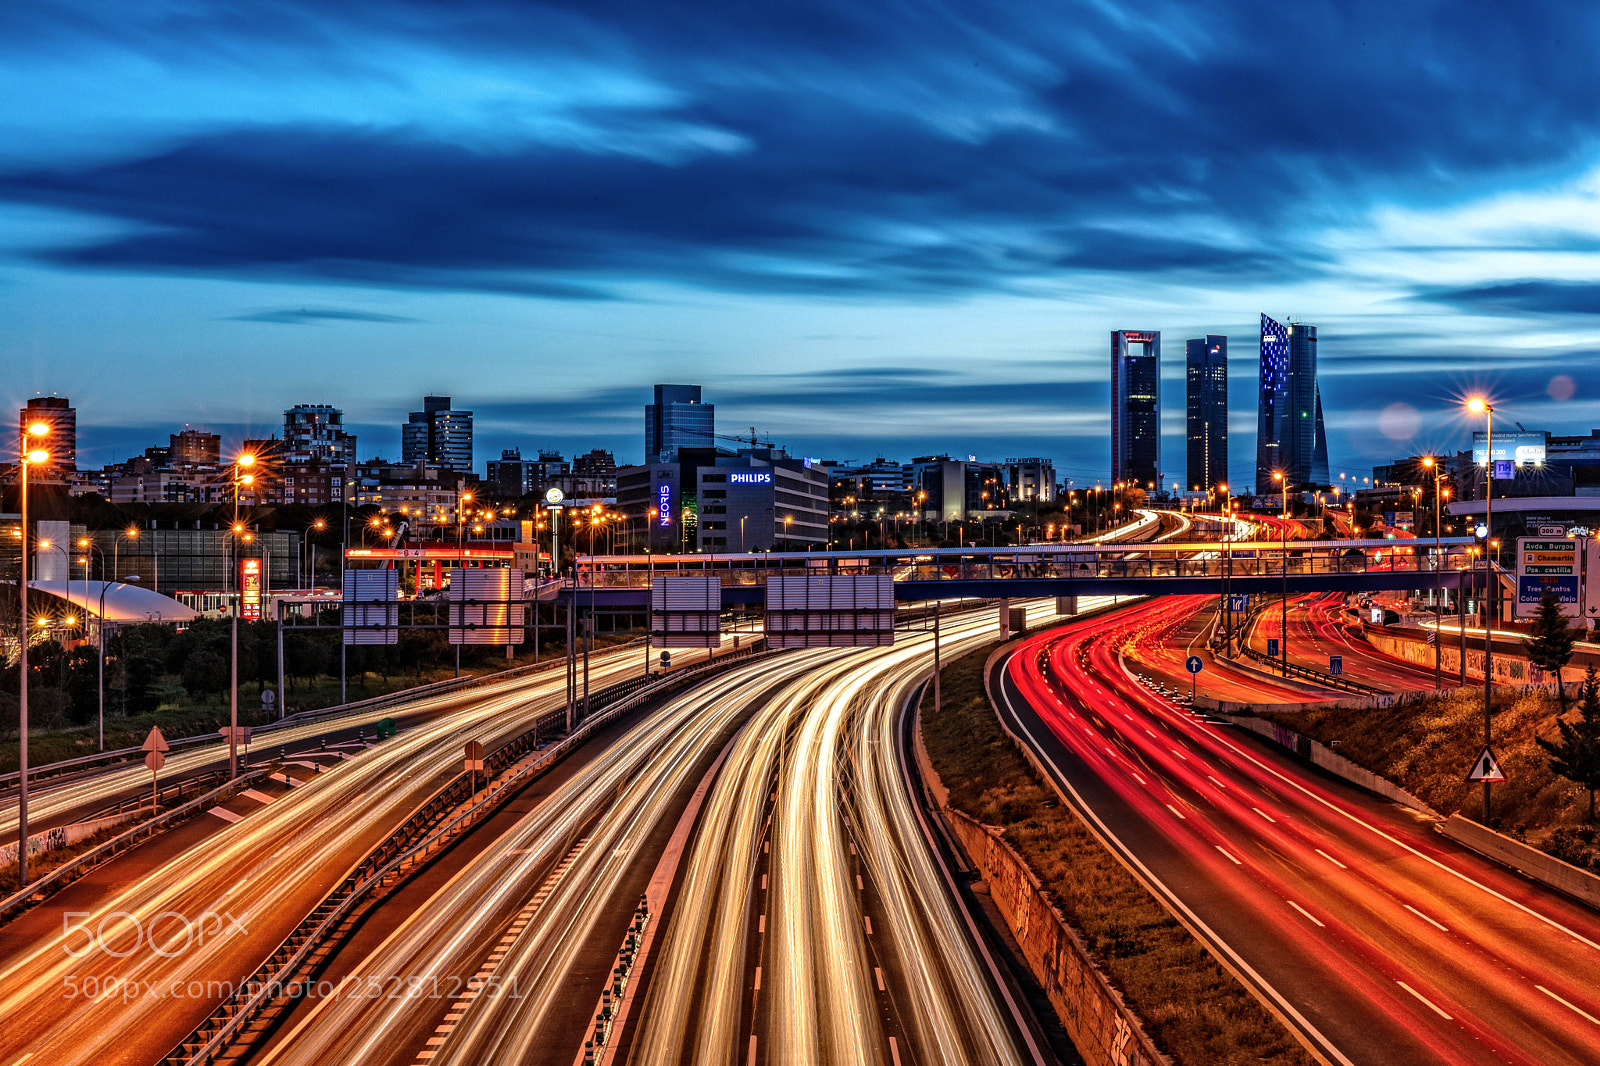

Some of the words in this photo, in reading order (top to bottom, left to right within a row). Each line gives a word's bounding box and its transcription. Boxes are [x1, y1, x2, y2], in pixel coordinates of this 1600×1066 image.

[731, 473, 770, 483] PHILIPS
[660, 485, 670, 526] NEORIS
[1549, 543, 1574, 551] Burgos
[1558, 595, 1577, 603] Viejo
